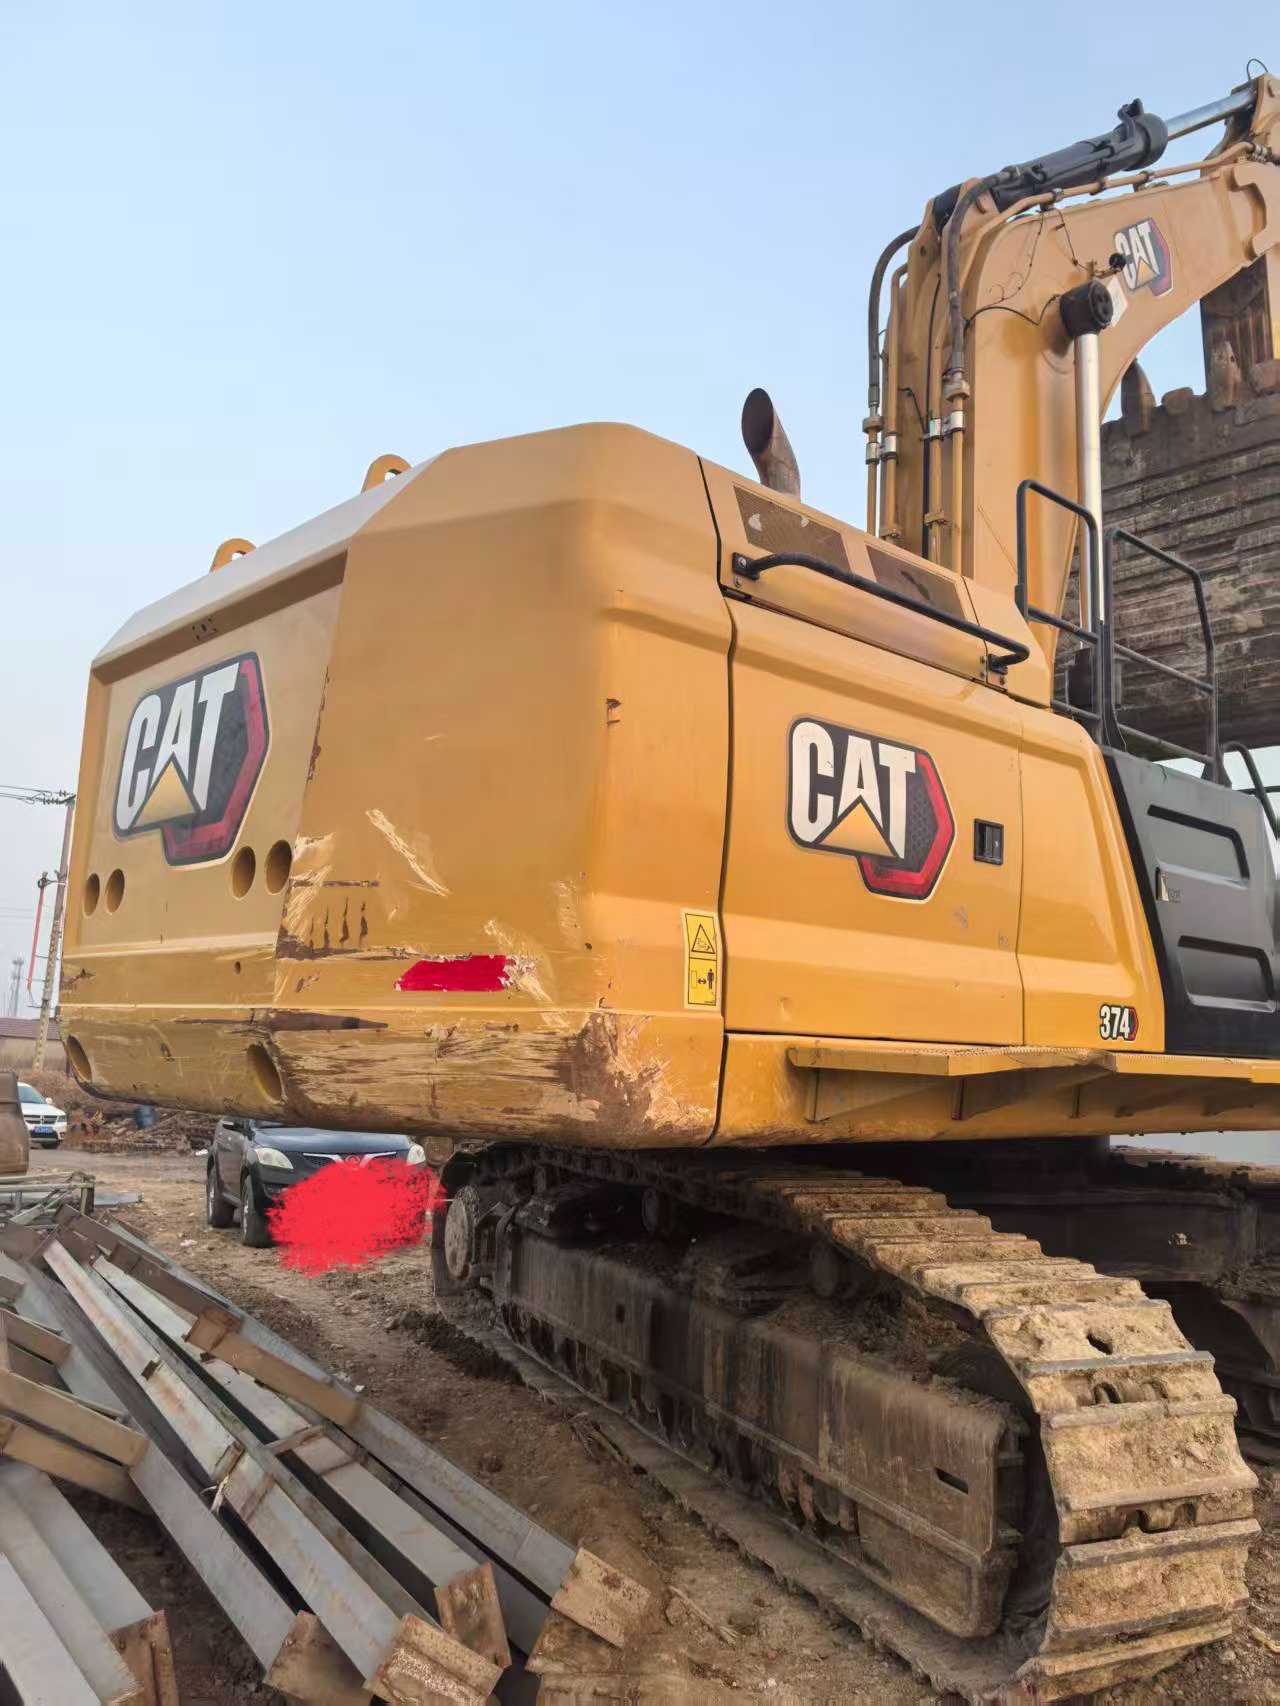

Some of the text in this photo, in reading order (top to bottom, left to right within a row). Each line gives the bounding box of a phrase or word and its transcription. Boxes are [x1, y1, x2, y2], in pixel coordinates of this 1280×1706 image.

[1115, 221, 1160, 289] CAT
[117, 662, 240, 830] CAT
[792, 721, 916, 859] CAT
[1100, 1005, 1130, 1039] 374
